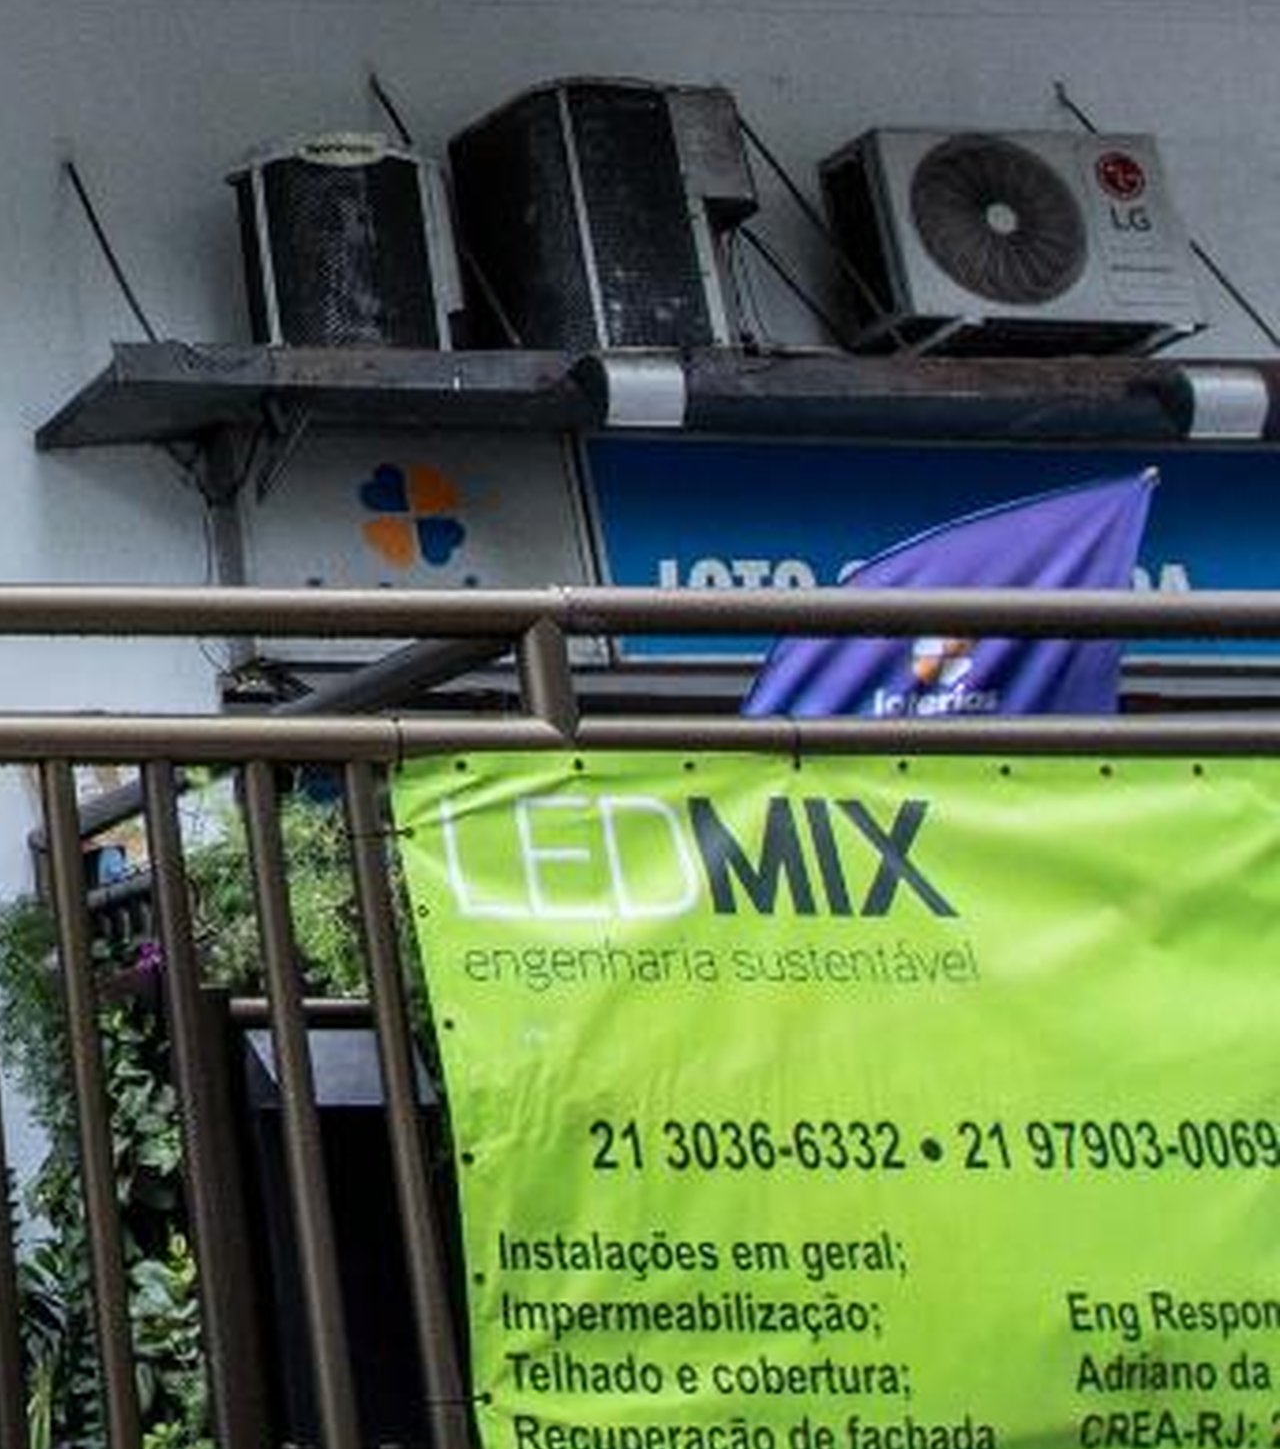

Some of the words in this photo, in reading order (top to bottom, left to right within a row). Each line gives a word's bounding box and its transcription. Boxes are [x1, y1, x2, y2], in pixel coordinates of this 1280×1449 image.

[1111, 206, 1152, 232] LG
[463, 937, 716, 990] engenharia
[734, 935, 979, 981] sustentável
[589, 1118, 643, 1171] 21
[664, 1118, 905, 1170] 3036-6332
[959, 1119, 1011, 1170] 21
[1027, 1118, 1280, 1169] 97903-0069
[499, 1230, 719, 1282] Instalações
[731, 1240, 789, 1271] em
[802, 1231, 908, 1281] geral;
[502, 1291, 884, 1342] Impermeabilização;
[1066, 1290, 1141, 1342] Eng
[1147, 1290, 1280, 1341] Respon
[505, 1350, 663, 1395] Telhado
[676, 1363, 699, 1394] e
[712, 1355, 913, 1401] cobertura;
[1075, 1353, 1217, 1393] Adriano
[1228, 1352, 1271, 1391] da
[1079, 1409, 1257, 1449] CREA-RJ:
